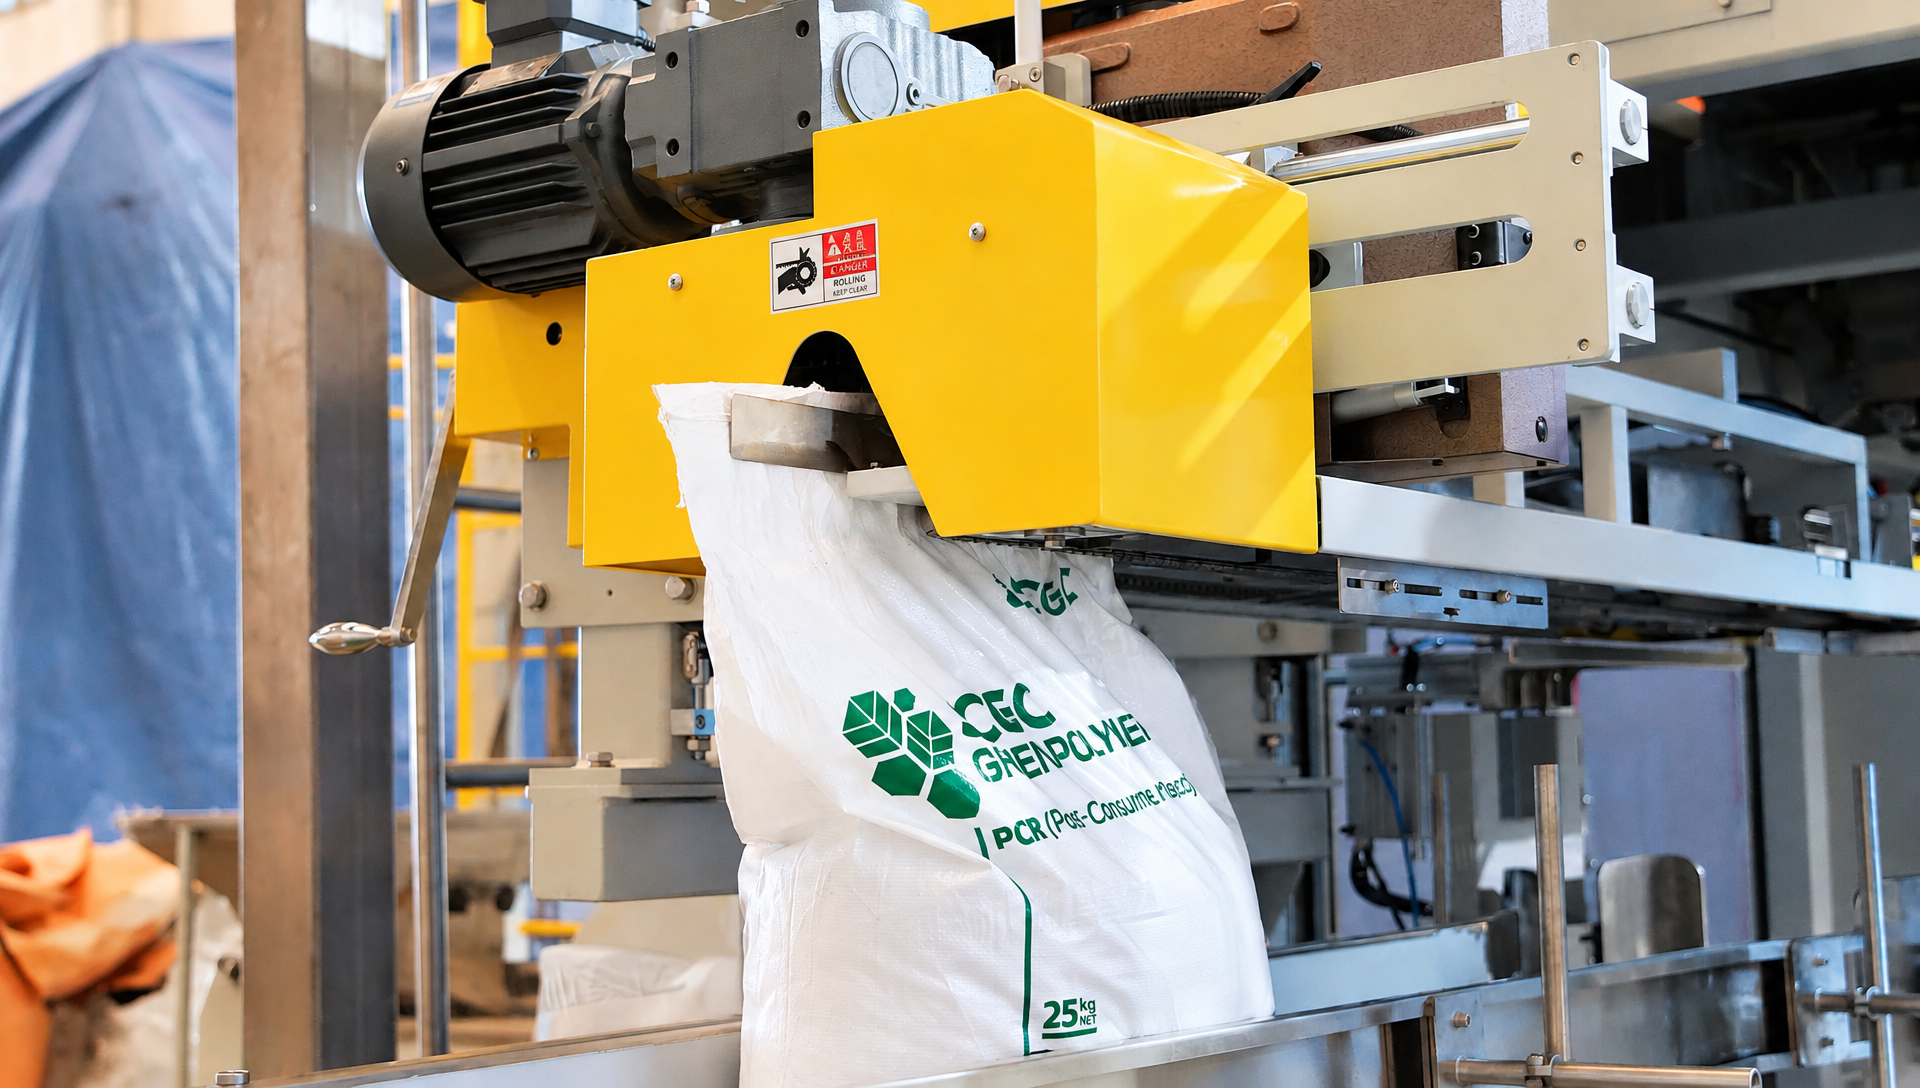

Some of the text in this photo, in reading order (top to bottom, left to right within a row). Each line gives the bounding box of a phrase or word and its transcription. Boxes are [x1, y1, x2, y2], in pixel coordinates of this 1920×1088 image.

[833, 275, 866, 287] ROLLING
[832, 285, 868, 297] KEEP CLEAR
[992, 817, 1049, 850] PCR
[1043, 997, 1097, 1029] 25 kg
[1080, 1014, 1097, 1026] NET
